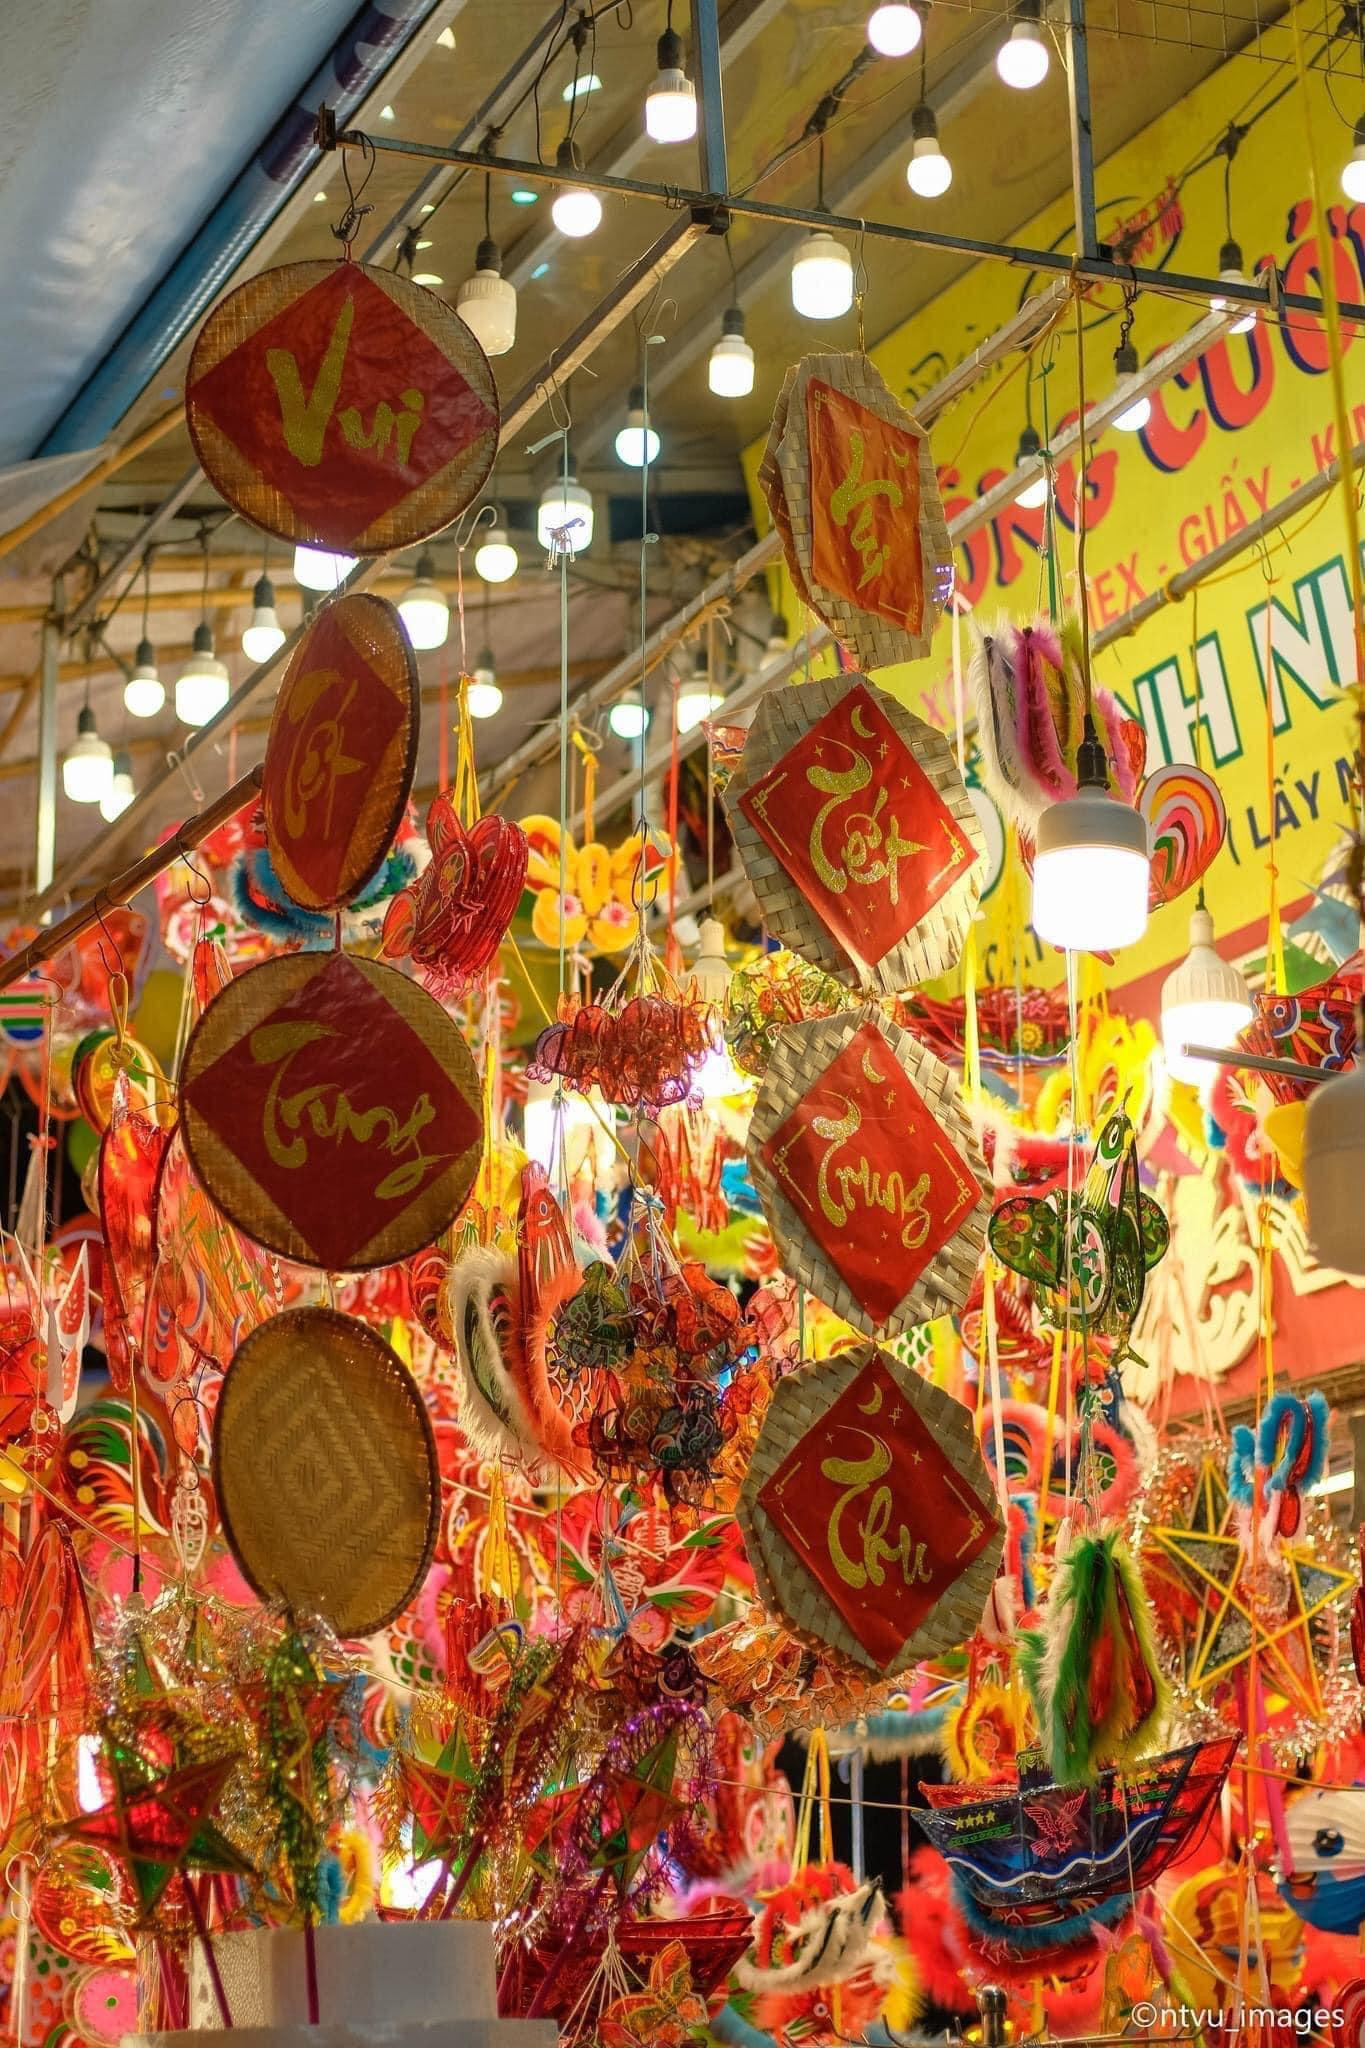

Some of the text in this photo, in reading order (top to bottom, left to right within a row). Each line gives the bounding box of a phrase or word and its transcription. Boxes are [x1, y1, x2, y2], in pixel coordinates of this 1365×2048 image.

[265, 294, 425, 467] Vui
[806, 735, 933, 906] Tết
[251, 1020, 459, 1200] Trung
[811, 1089, 931, 1249] Trung
[820, 1424, 933, 1589] Thu
